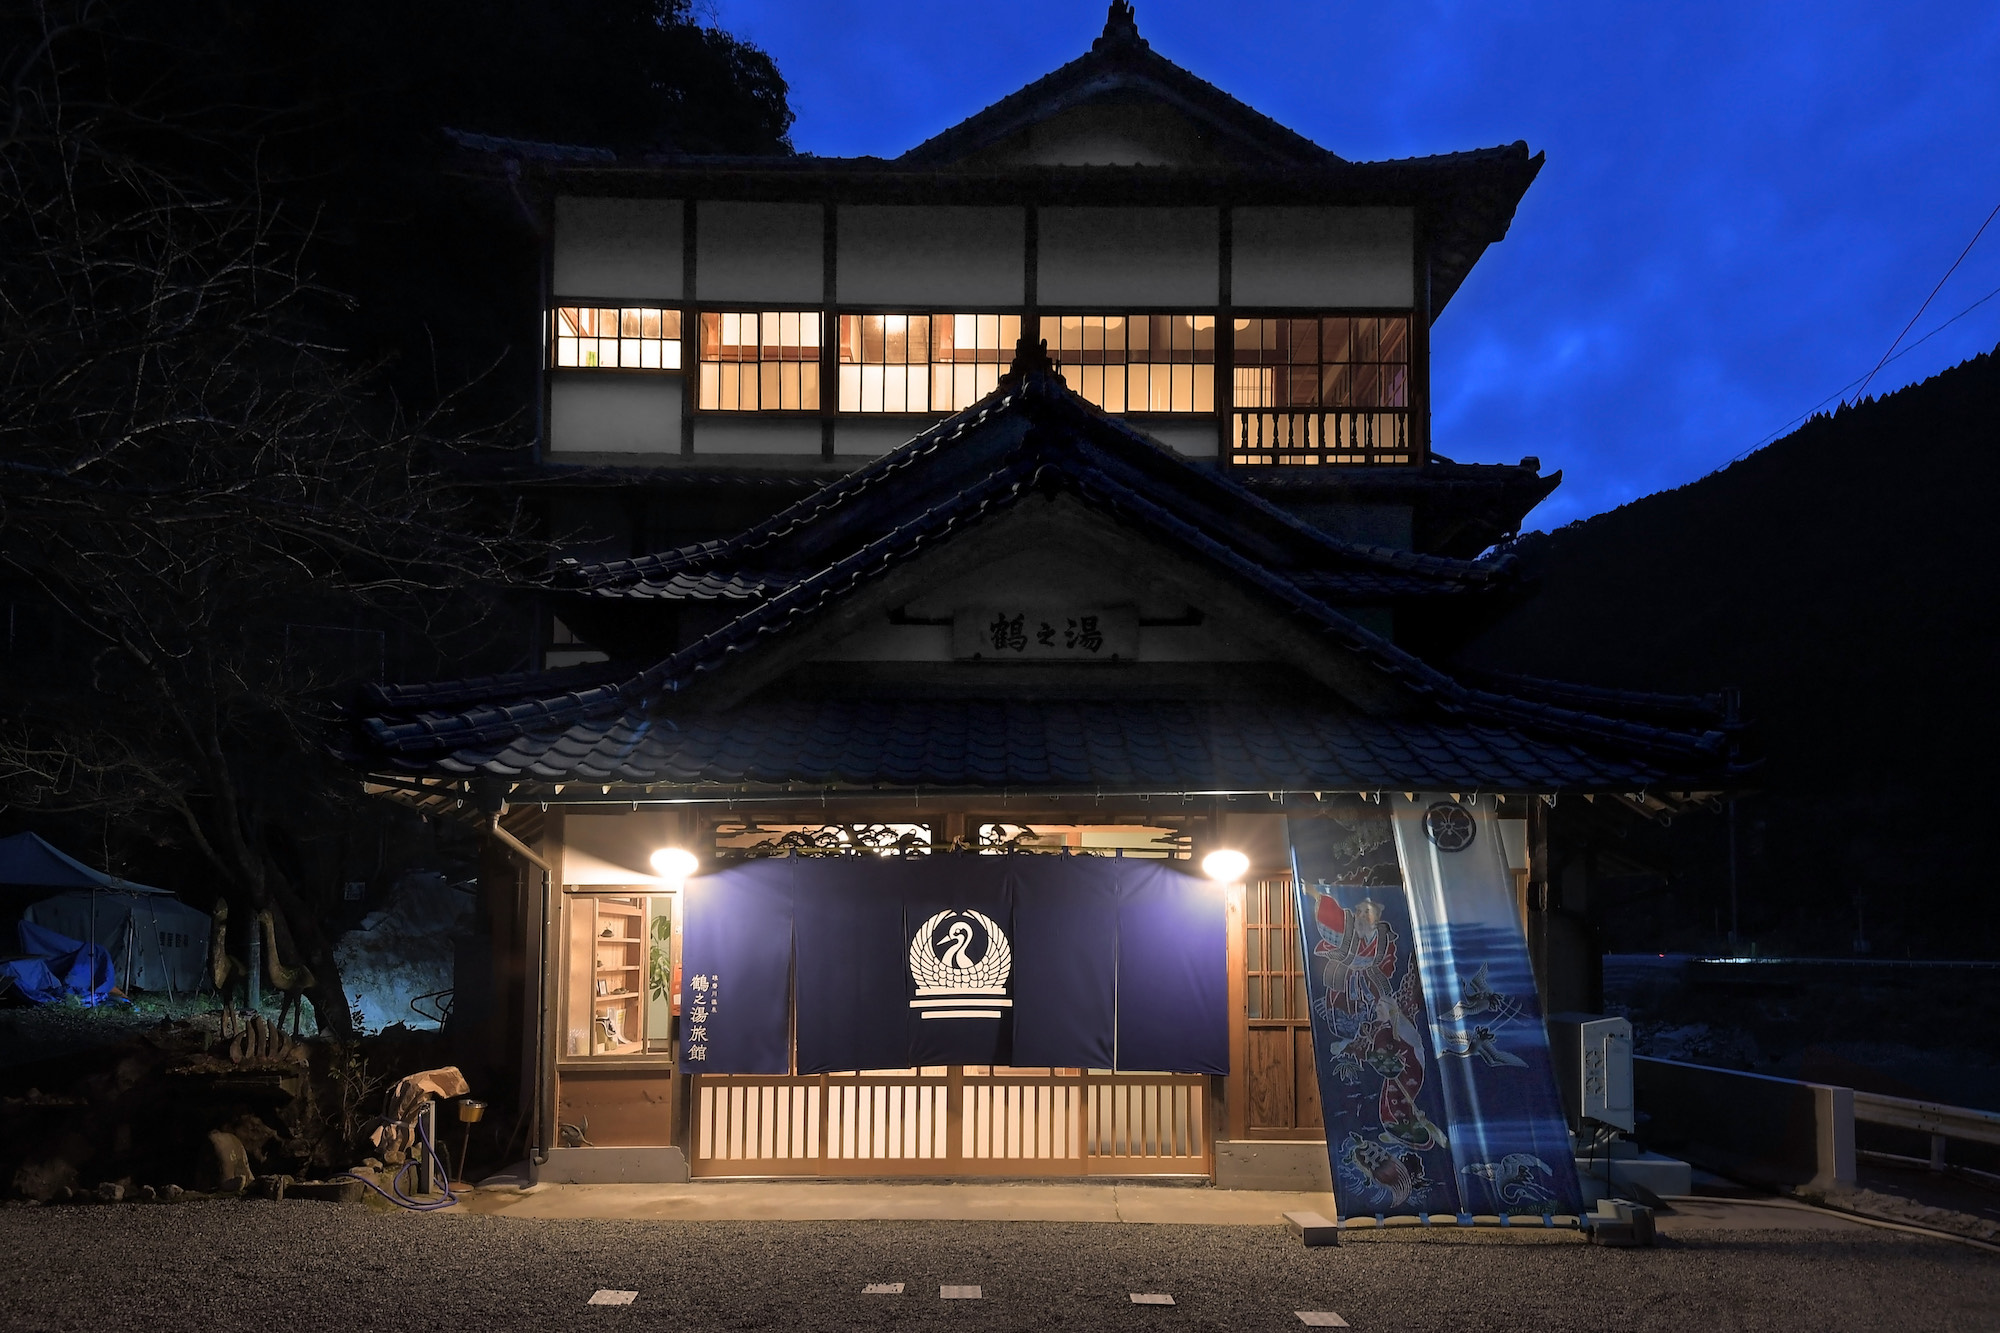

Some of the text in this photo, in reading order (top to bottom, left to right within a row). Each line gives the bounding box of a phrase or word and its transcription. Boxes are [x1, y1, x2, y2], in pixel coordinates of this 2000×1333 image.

[990, 612, 1103, 652] 鶴之湯
[688, 974, 709, 1061] 鶴之湯旅館
